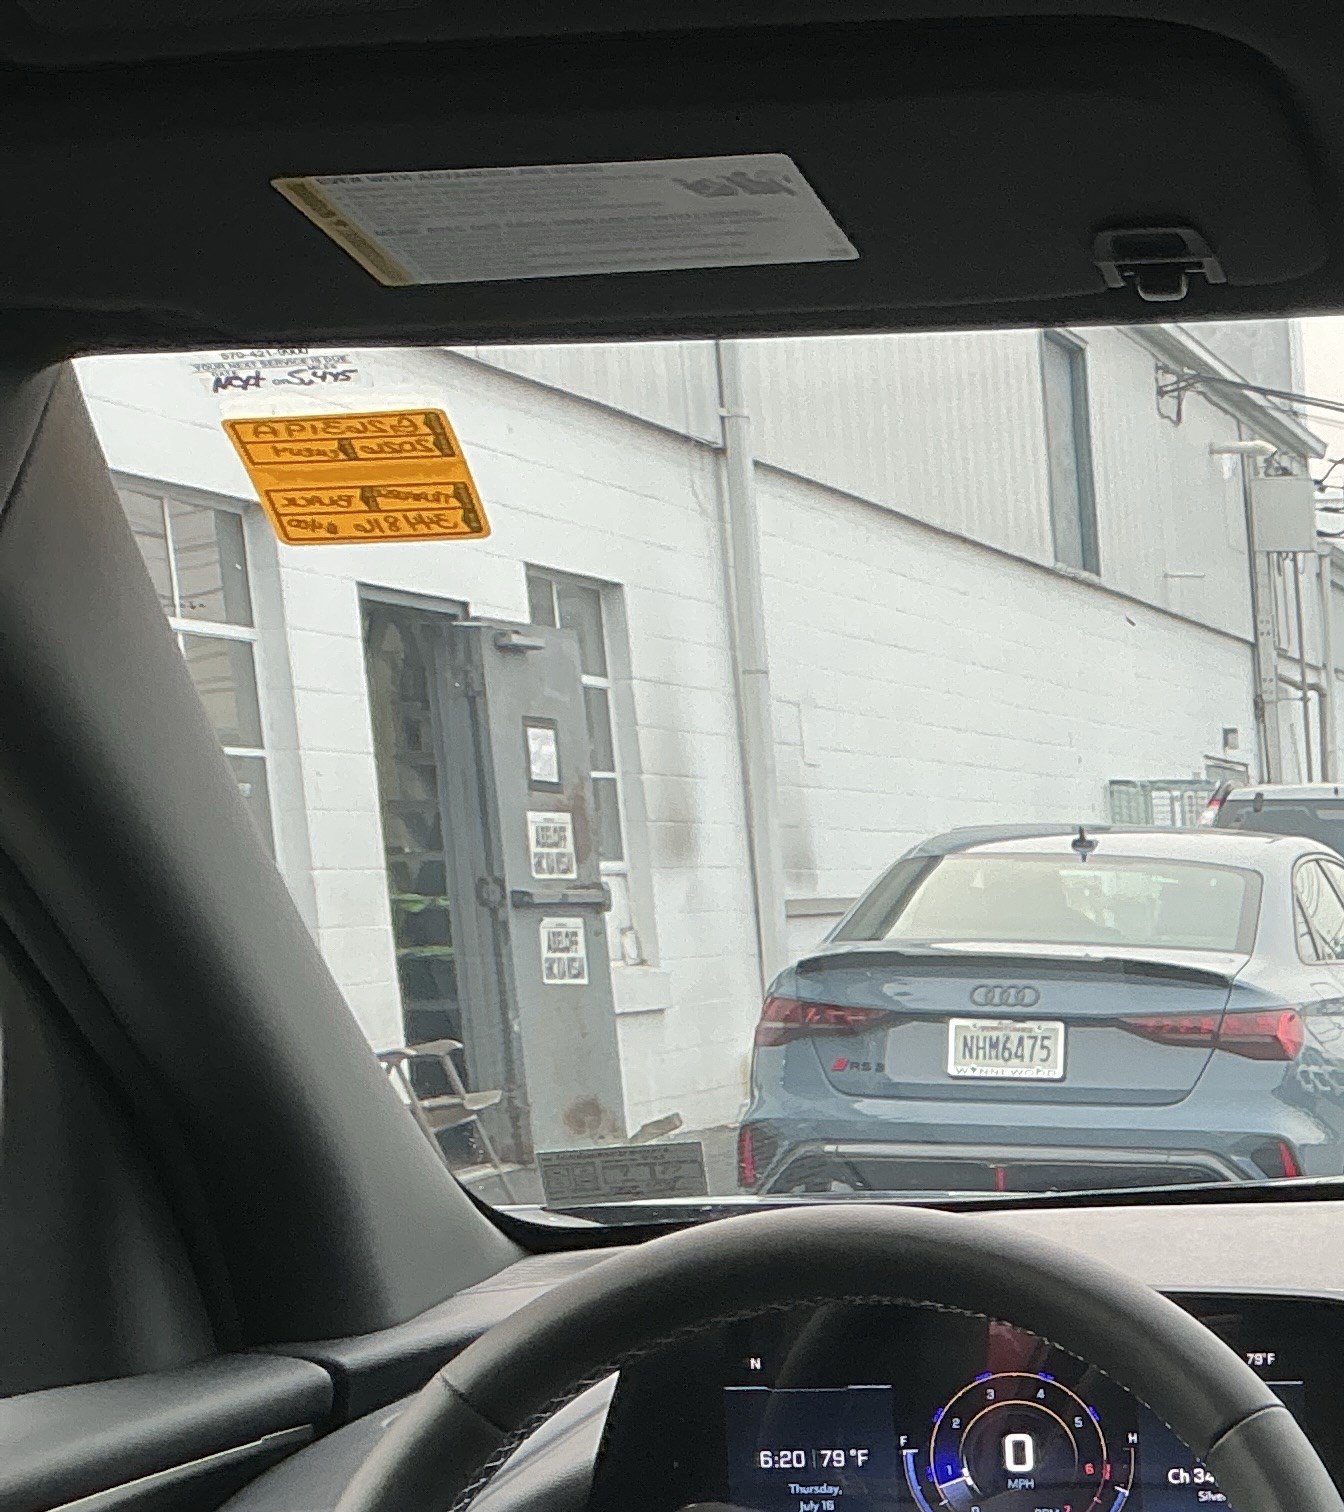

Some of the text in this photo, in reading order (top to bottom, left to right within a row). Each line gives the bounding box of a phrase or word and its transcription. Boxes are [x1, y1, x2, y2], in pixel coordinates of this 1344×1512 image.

[961, 1034, 1052, 1062] NHM6475
[749, 1357, 762, 1370] N
[986, 1388, 996, 1400] 3
[1035, 1388, 1046, 1400] 4
[951, 1417, 961, 1429] 2
[1074, 1416, 1084, 1429] 5
[899, 1435, 908, 1447] F
[1127, 1432, 1138, 1445] H
[1003, 1432, 1034, 1472] 0
[758, 1449, 806, 1469] 6:20
[820, 1449, 846, 1468] 79
[1083, 1462, 1095, 1475] 6
[1167, 1468, 1190, 1484] Ch
[1007, 1478, 1036, 1490] MPH
